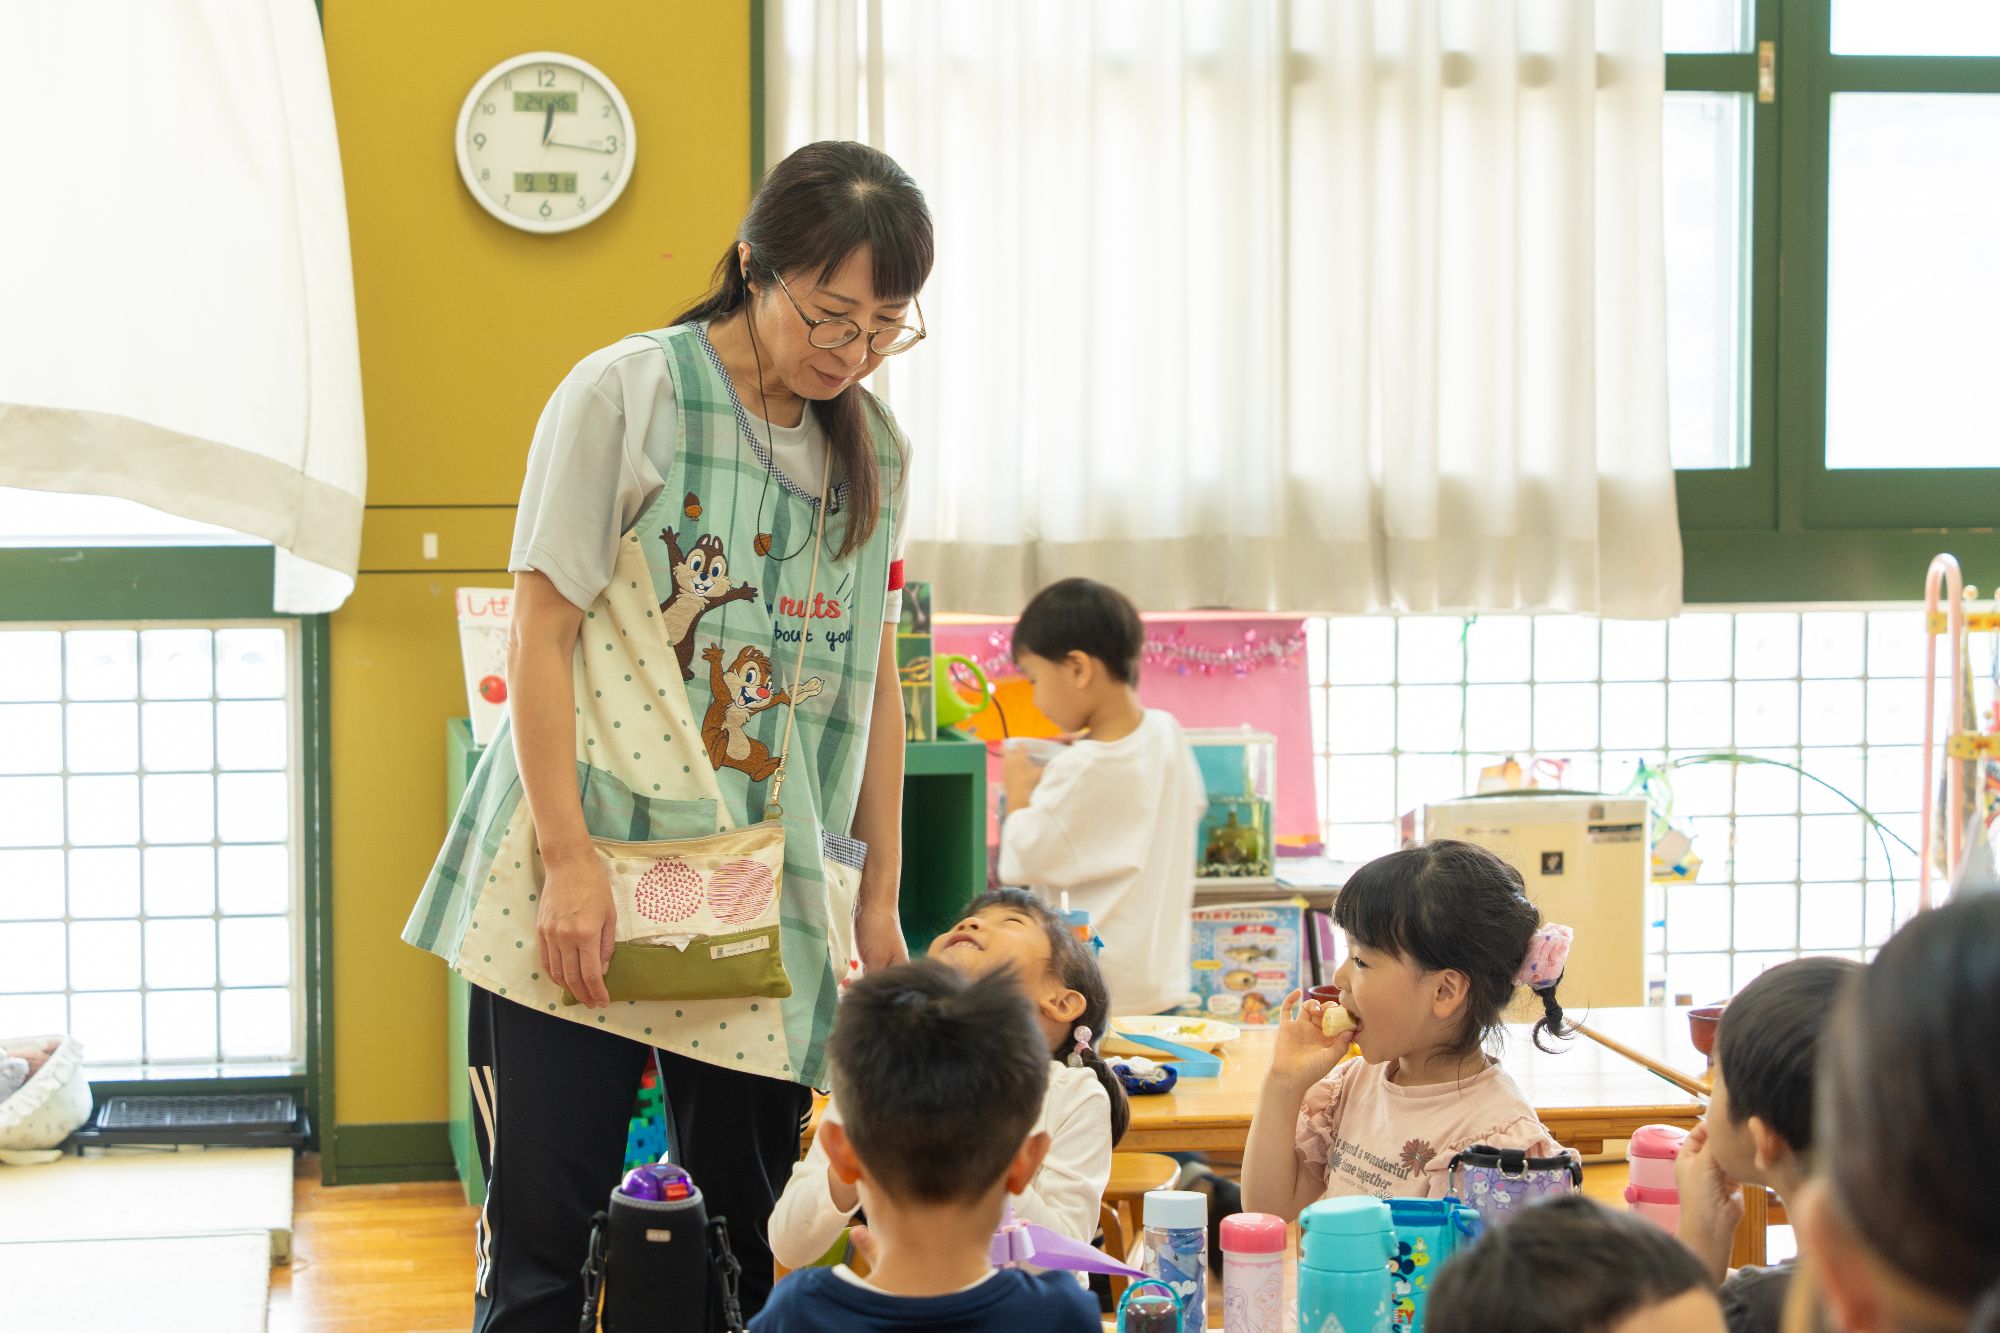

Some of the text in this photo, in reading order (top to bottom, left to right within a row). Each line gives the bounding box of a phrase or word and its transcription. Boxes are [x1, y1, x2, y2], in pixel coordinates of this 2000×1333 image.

[538, 69, 556, 88] 12
[482, 103, 496, 116] 10
[601, 106, 611, 118] 2
[473, 132, 487, 152] 9
[605, 135, 618, 155] 3
[481, 168, 490, 181] 8
[601, 171, 610, 182] 4
[503, 194, 511, 206] 7
[539, 198, 552, 217] 6
[577, 196, 586, 209] 5
[779, 591, 841, 619] nuts
[1341, 1140, 1361, 1157] spend
[1363, 1150, 1413, 1181] wonderful
[1356, 1166, 1393, 1190] together
